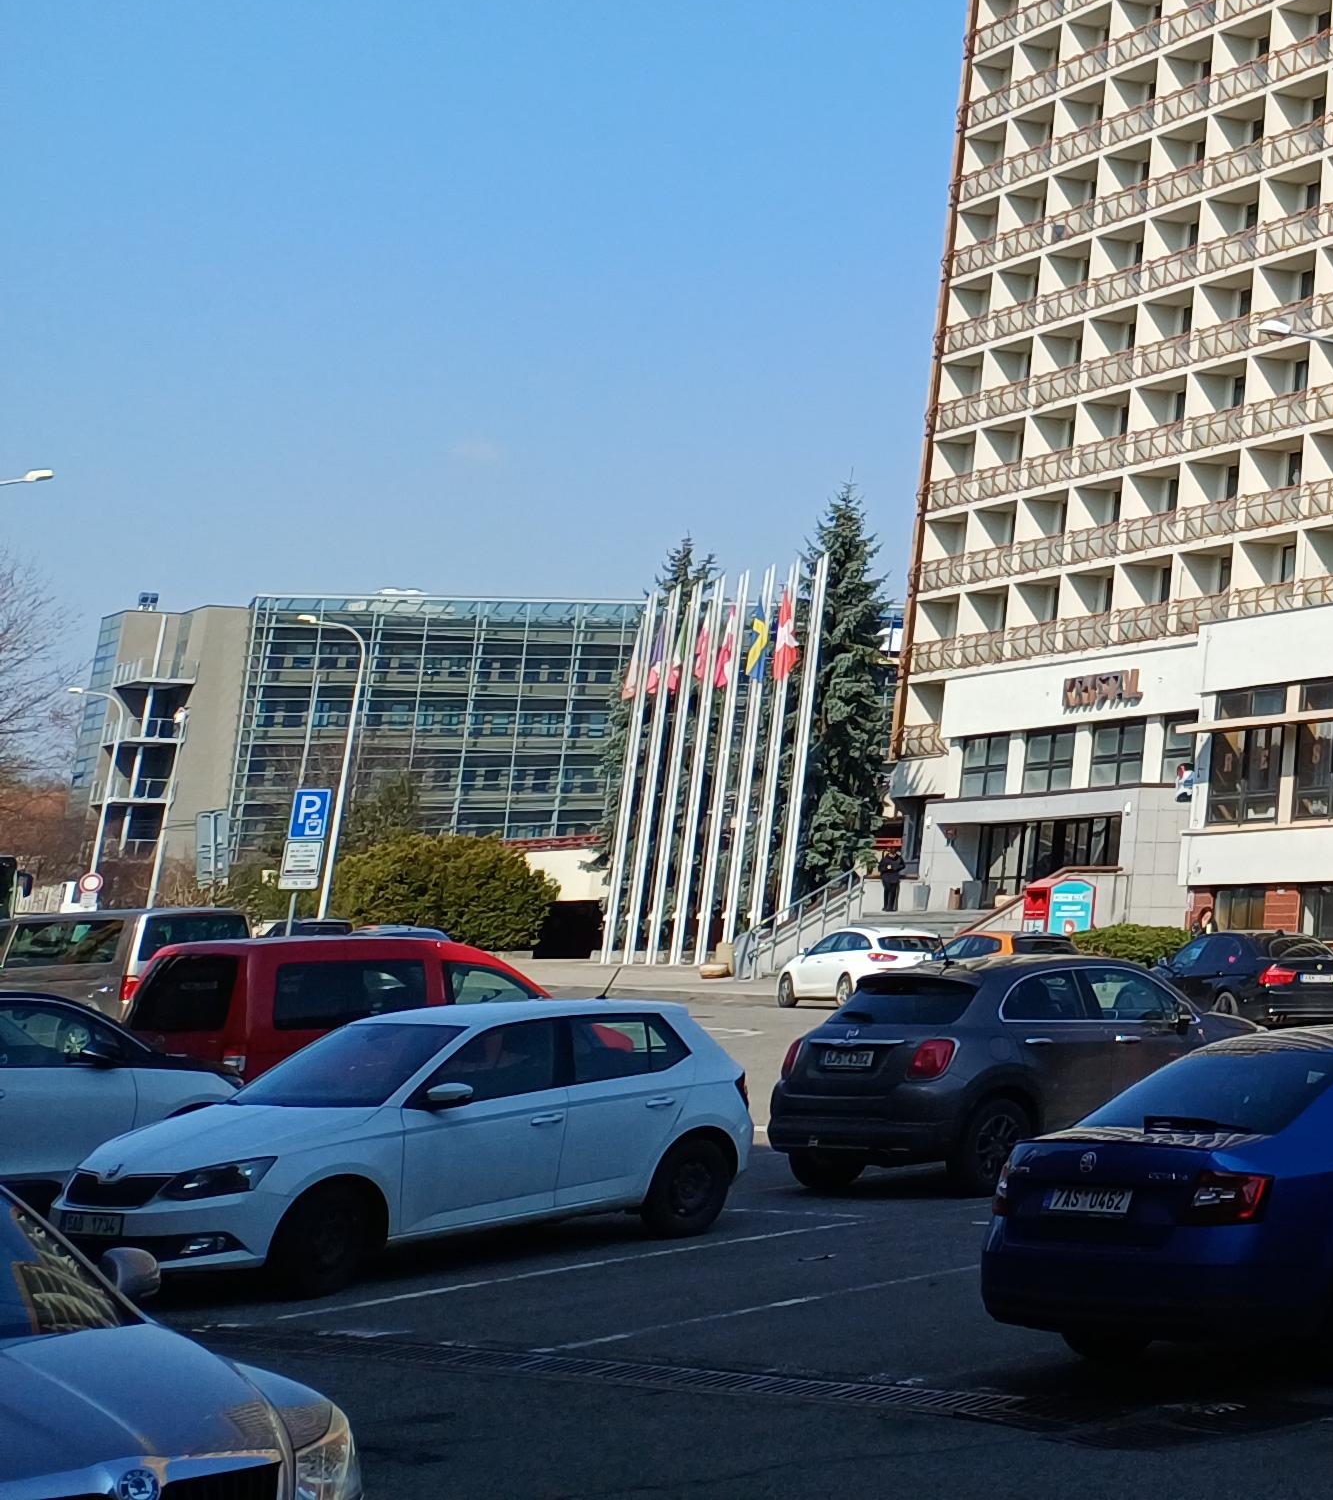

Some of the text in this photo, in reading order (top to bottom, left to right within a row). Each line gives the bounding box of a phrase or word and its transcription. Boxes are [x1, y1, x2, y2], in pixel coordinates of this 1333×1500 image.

[298, 795, 322, 824] P
[1054, 1188, 1127, 1210] 7AS 0462
